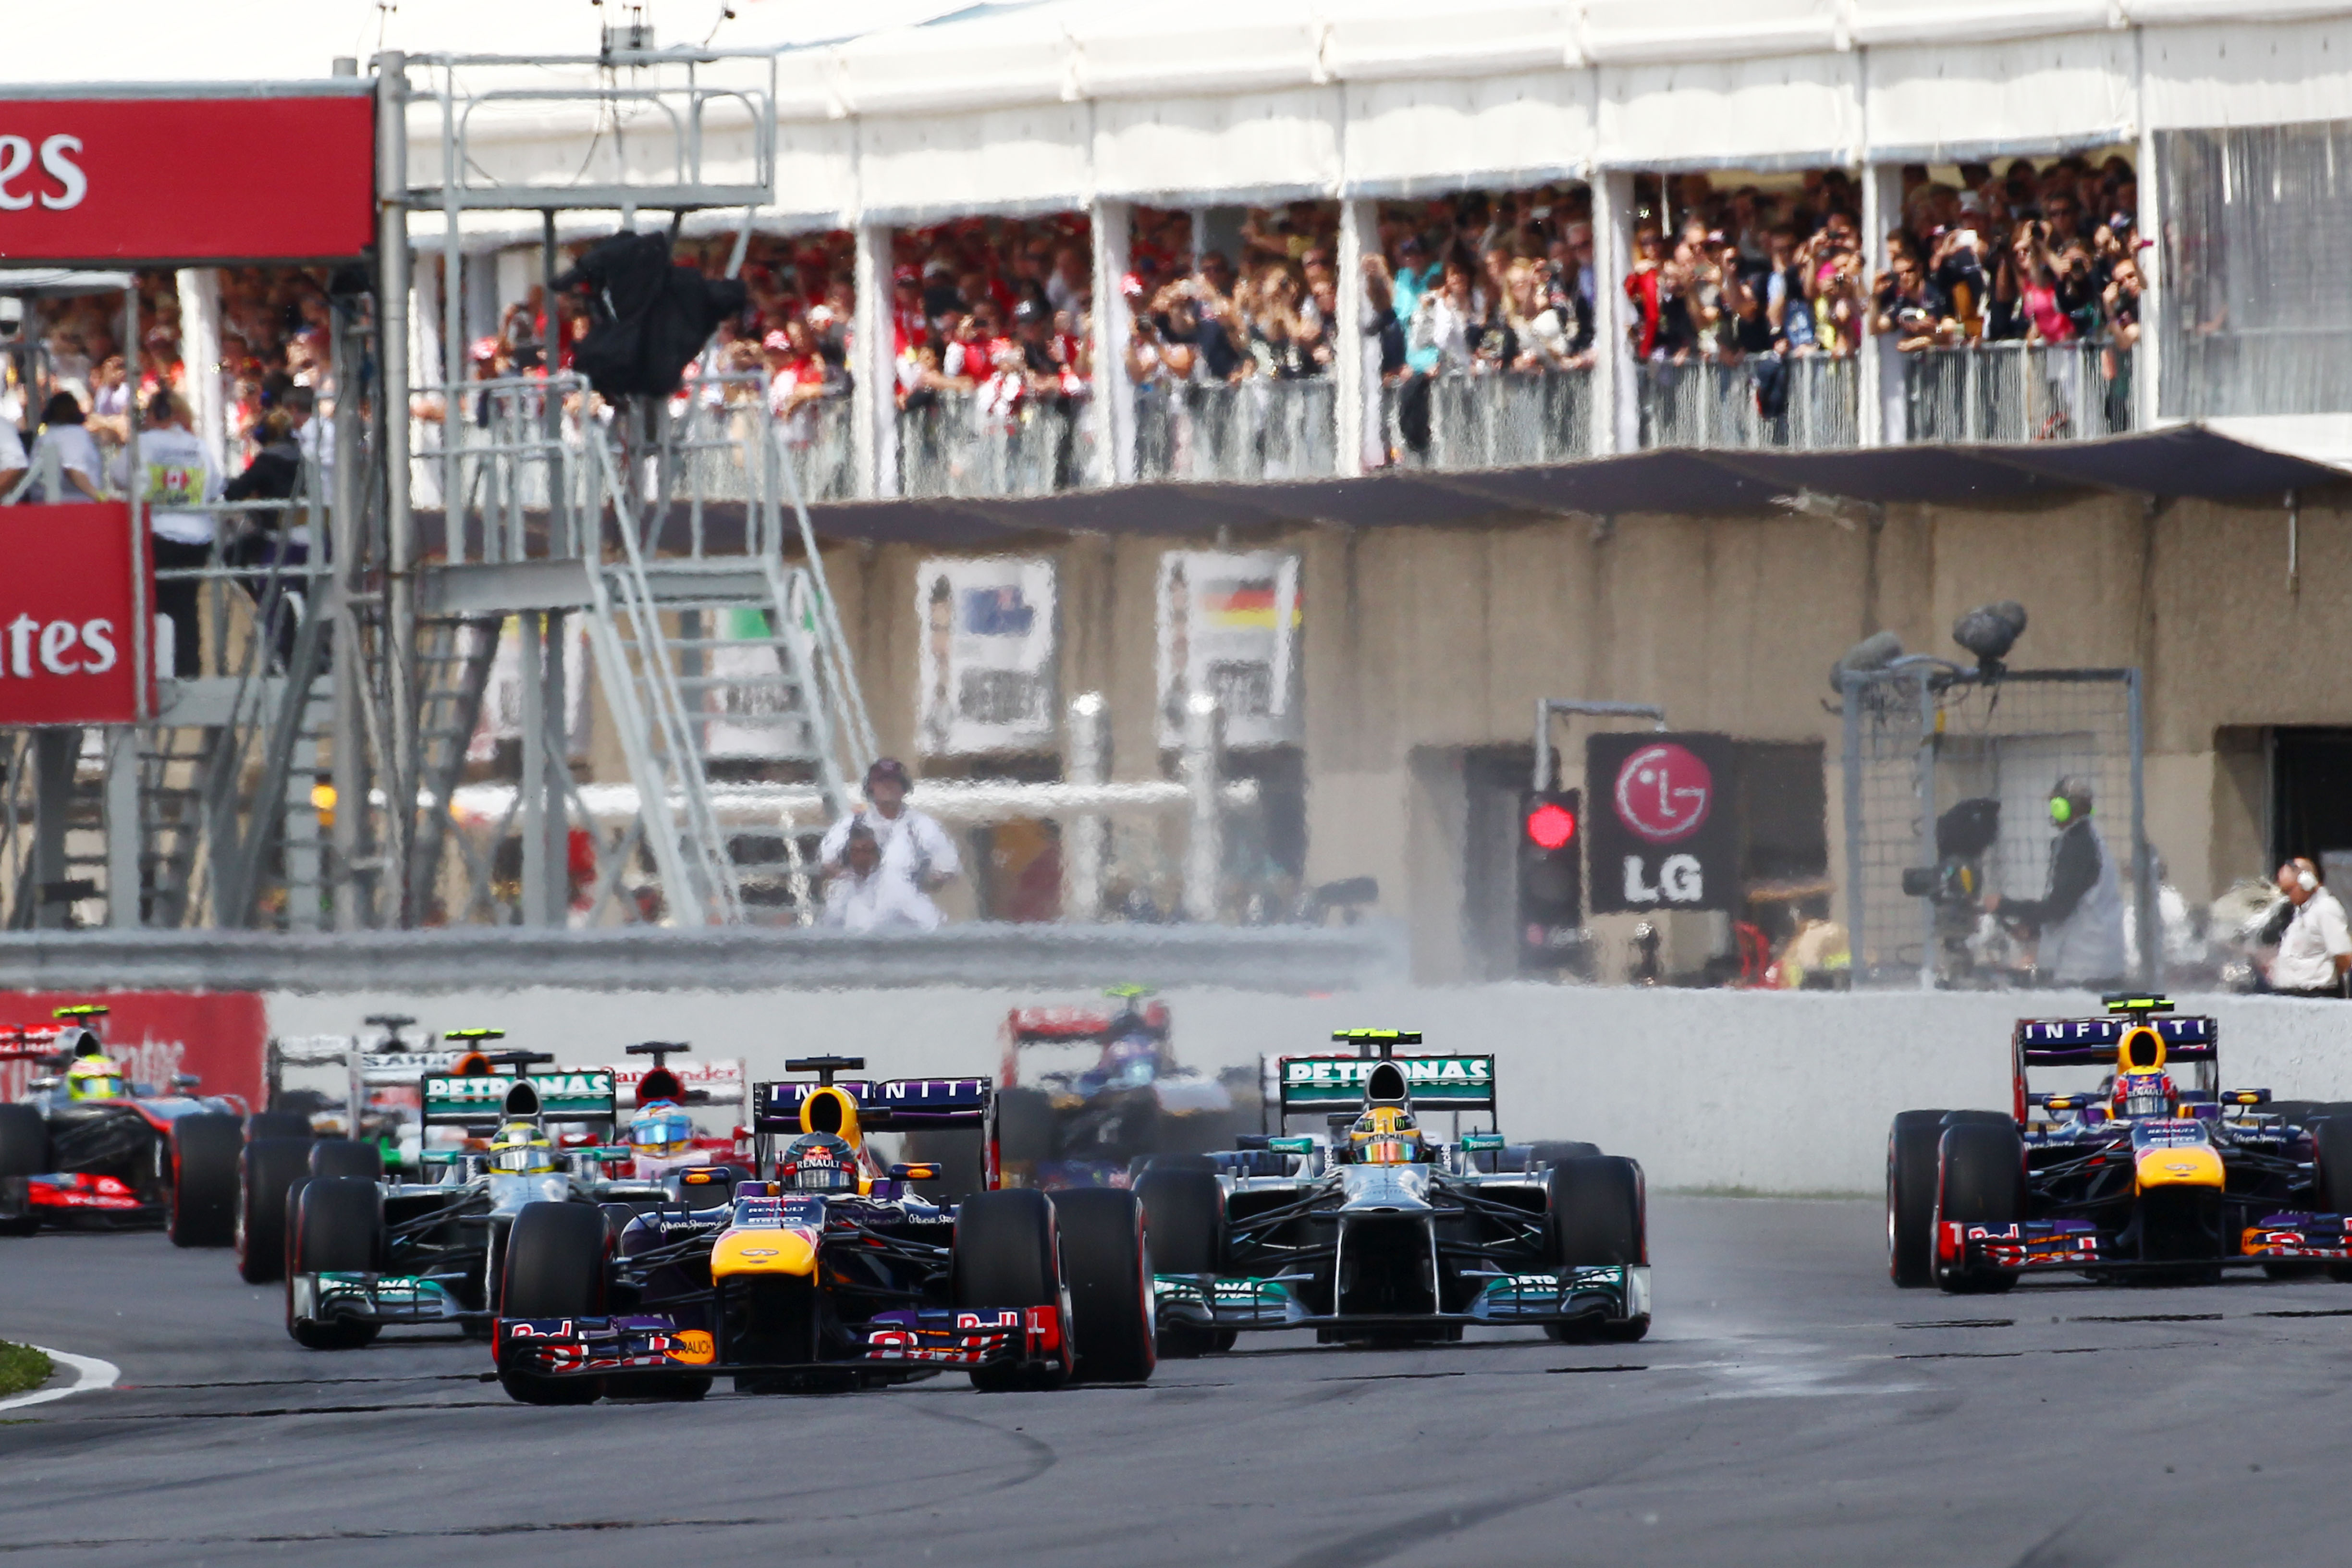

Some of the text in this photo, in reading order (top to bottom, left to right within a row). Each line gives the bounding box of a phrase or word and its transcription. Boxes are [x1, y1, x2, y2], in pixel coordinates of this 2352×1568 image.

[0, 612, 118, 678] tes
[1623, 853, 1703, 903] LG
[796, 1159, 841, 1169] RENAULT
[908, 1213, 937, 1225] Pepe
[660, 1221, 688, 1233] Pepe
[957, 1311, 1019, 1329] Bll
